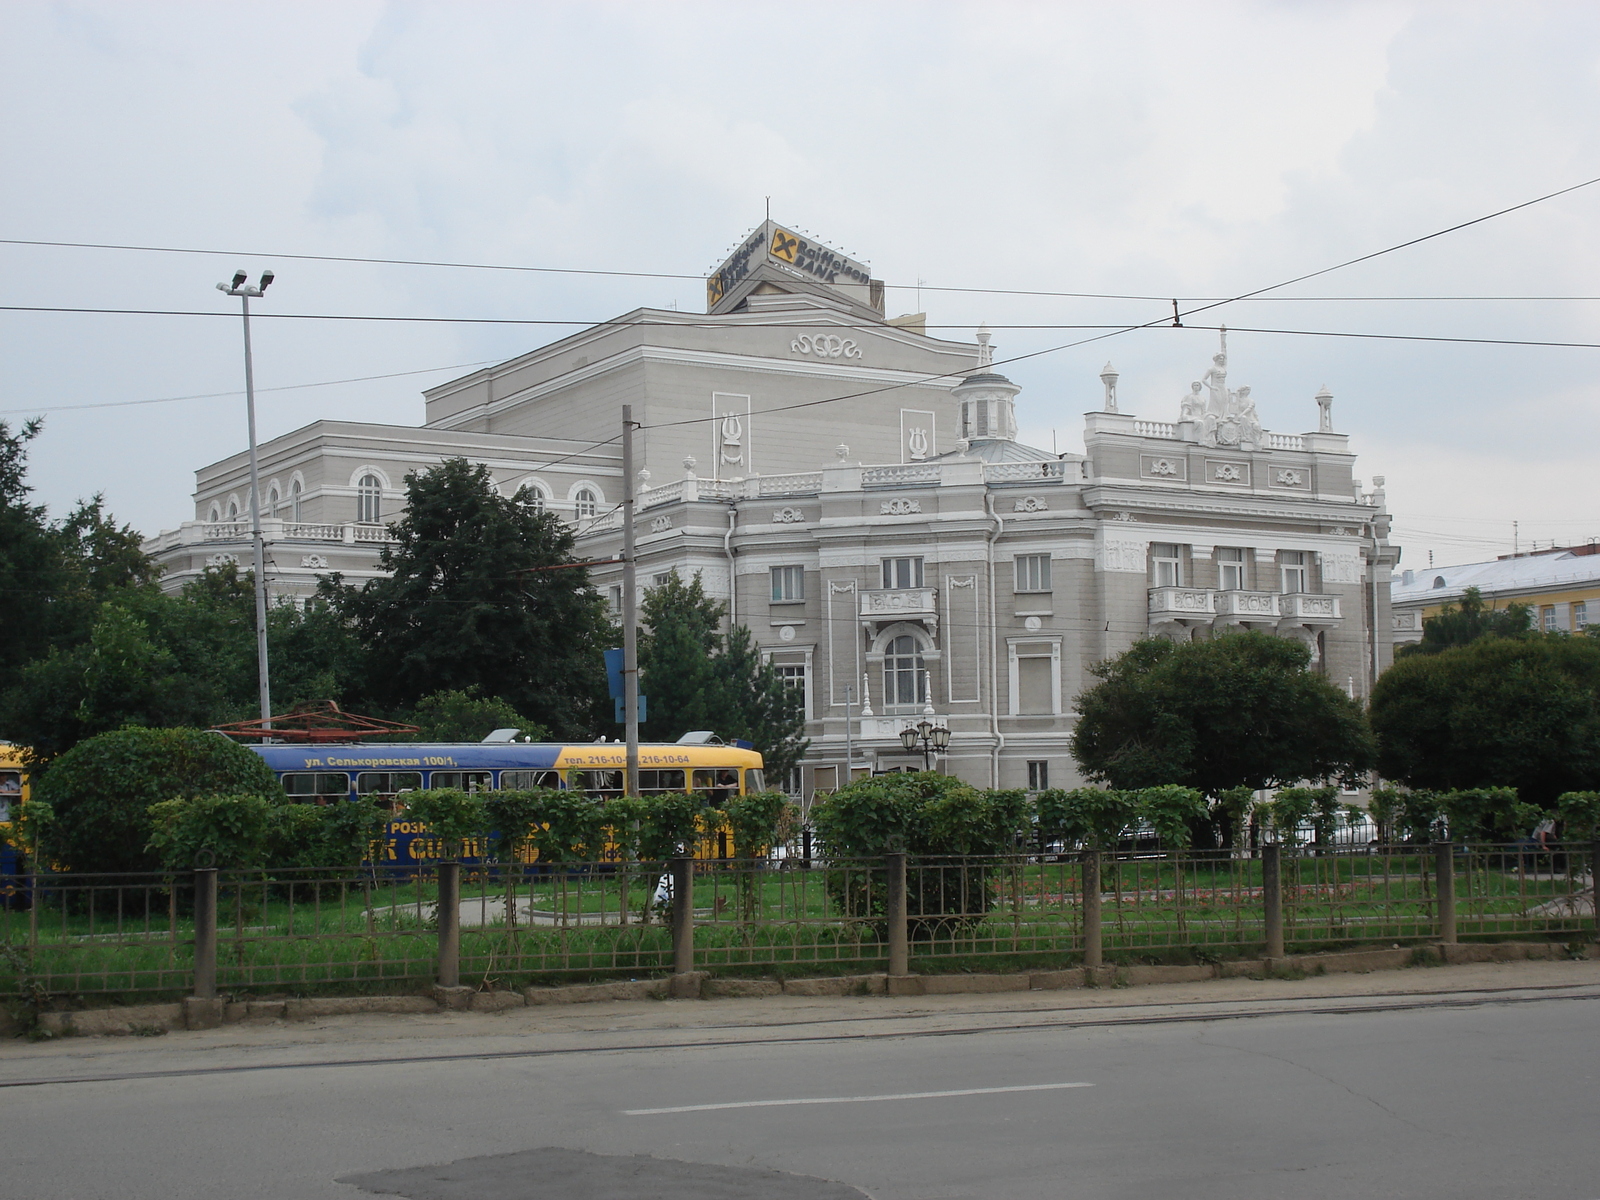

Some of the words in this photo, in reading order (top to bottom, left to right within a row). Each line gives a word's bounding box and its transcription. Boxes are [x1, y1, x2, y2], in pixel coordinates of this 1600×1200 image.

[794, 254, 839, 284] BANK
[797, 240, 870, 284] Raiffeisen
[304, 758, 324, 768] ул.
